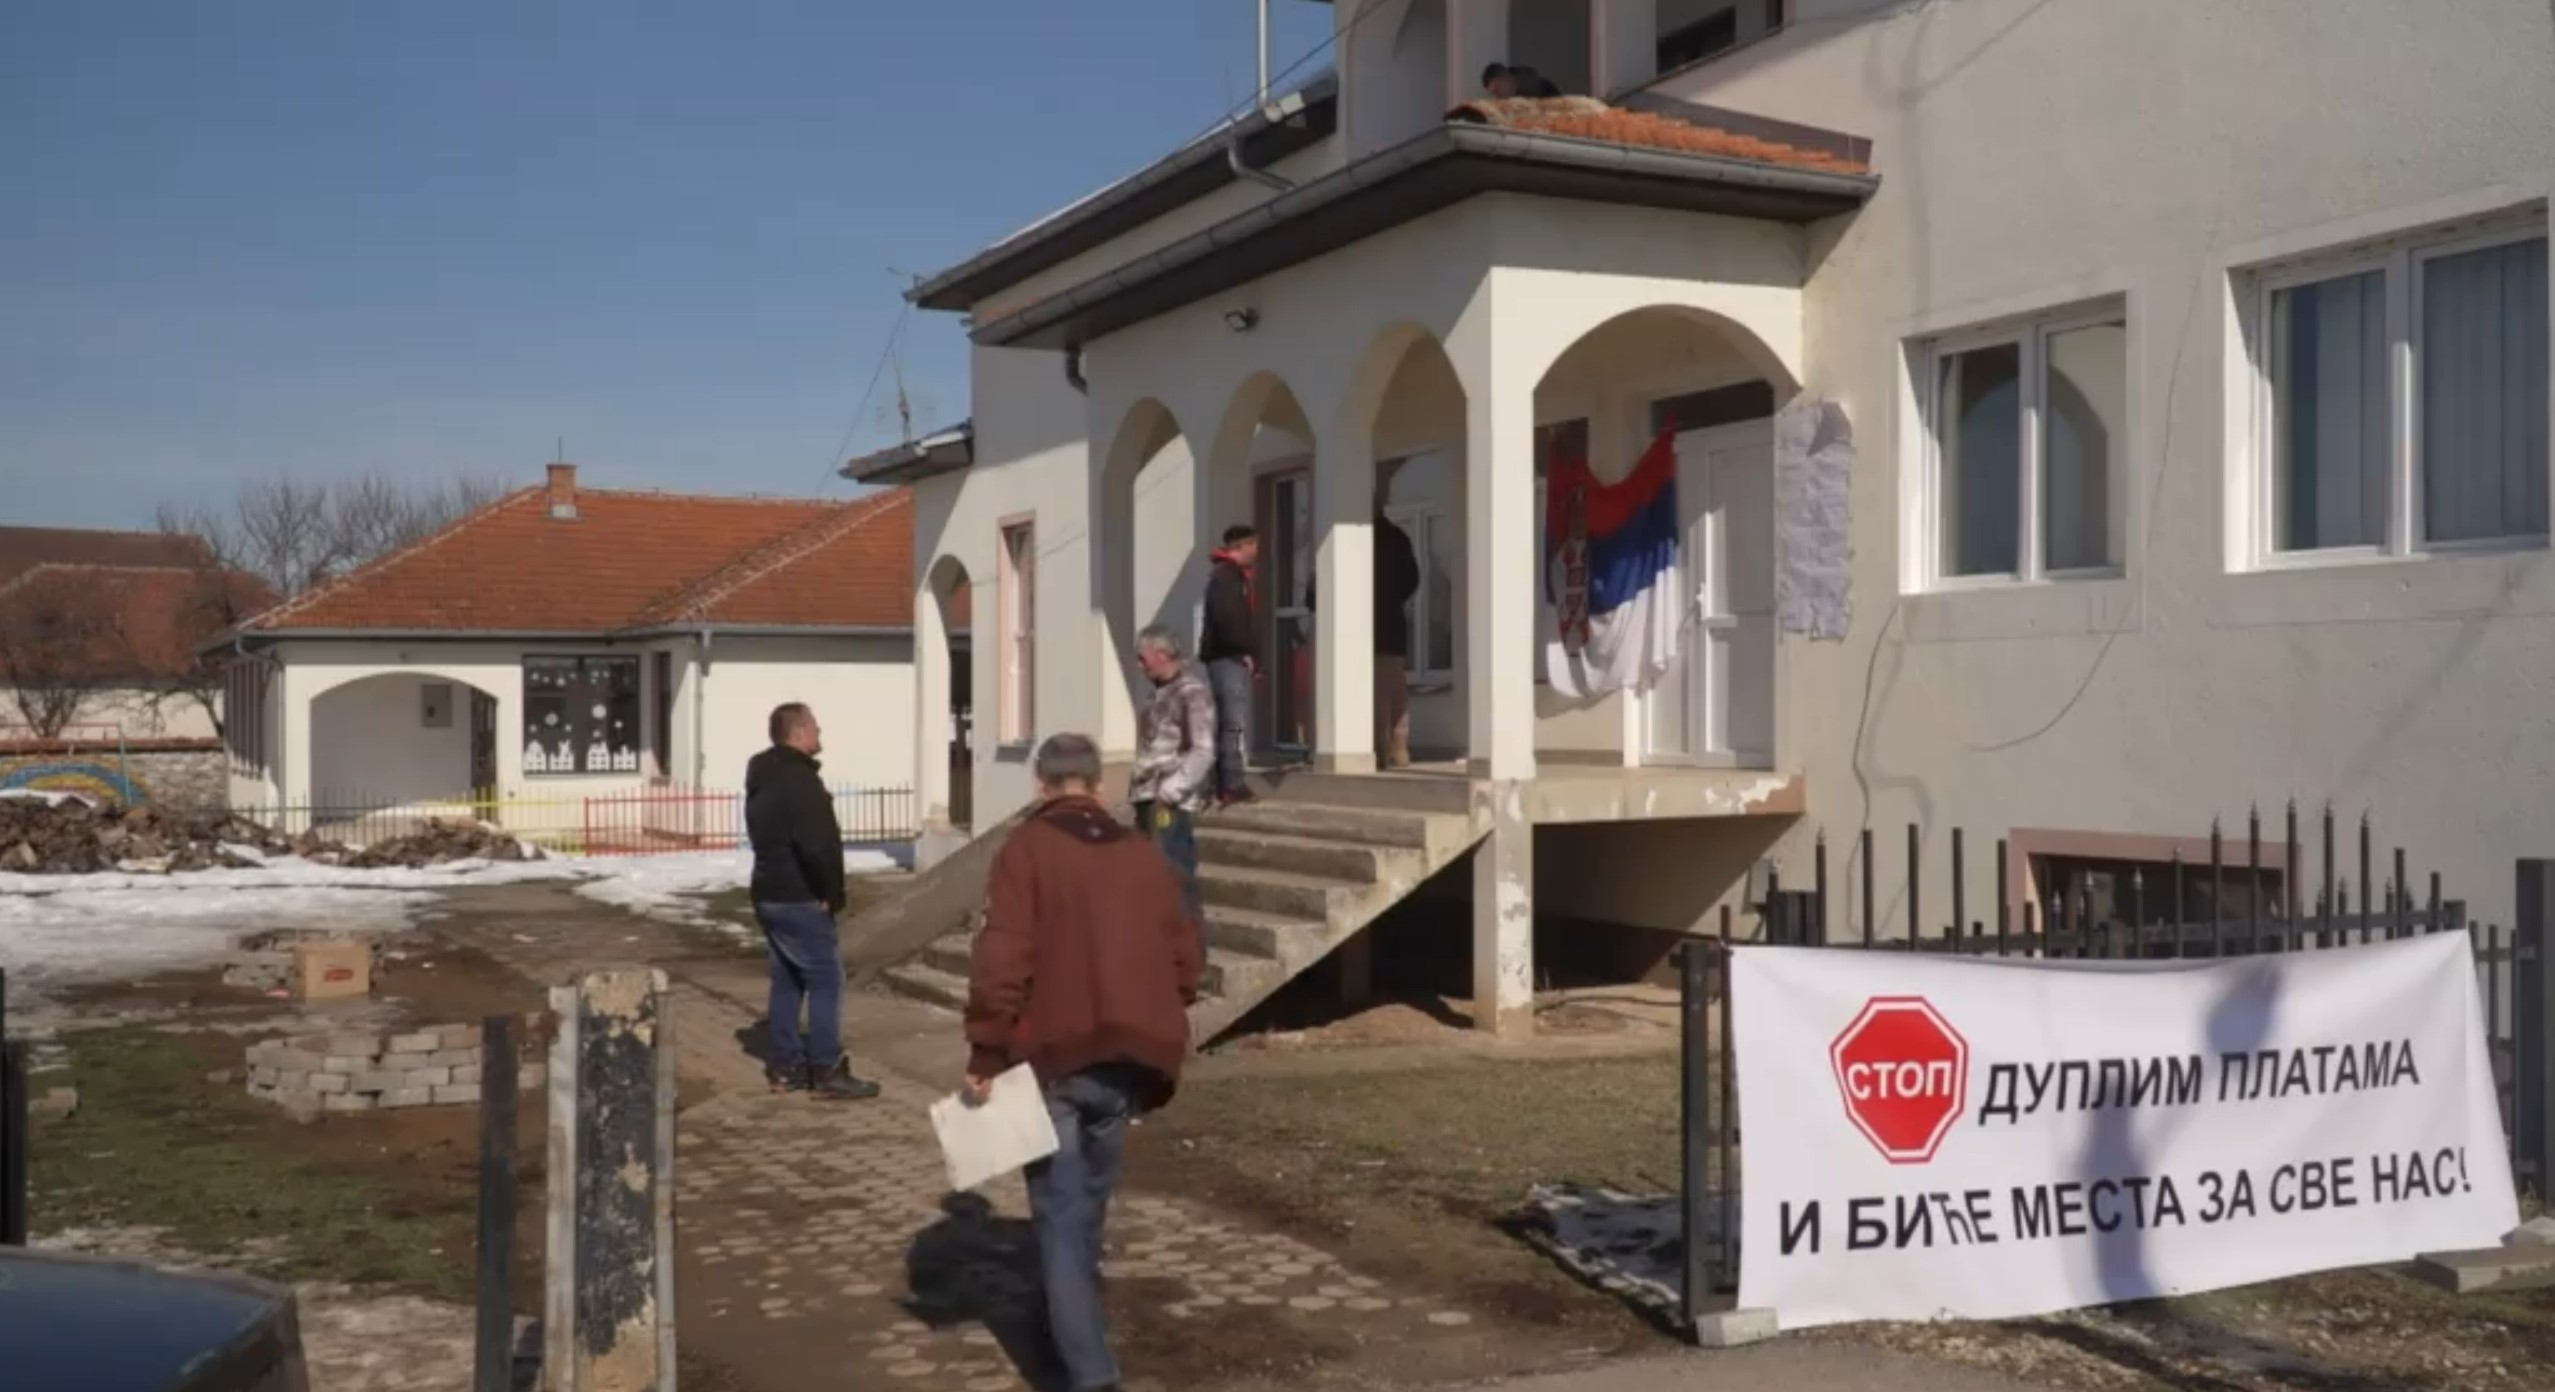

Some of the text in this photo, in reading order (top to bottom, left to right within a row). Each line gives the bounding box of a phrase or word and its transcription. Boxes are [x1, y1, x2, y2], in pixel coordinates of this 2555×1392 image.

[1846, 1038, 2421, 1127] СТОП ДУПЛИМ ПЛАТАМА
[1779, 1146, 2472, 1256] И БИЋЕ МЕСТА ЗА СВЕ НАС!
